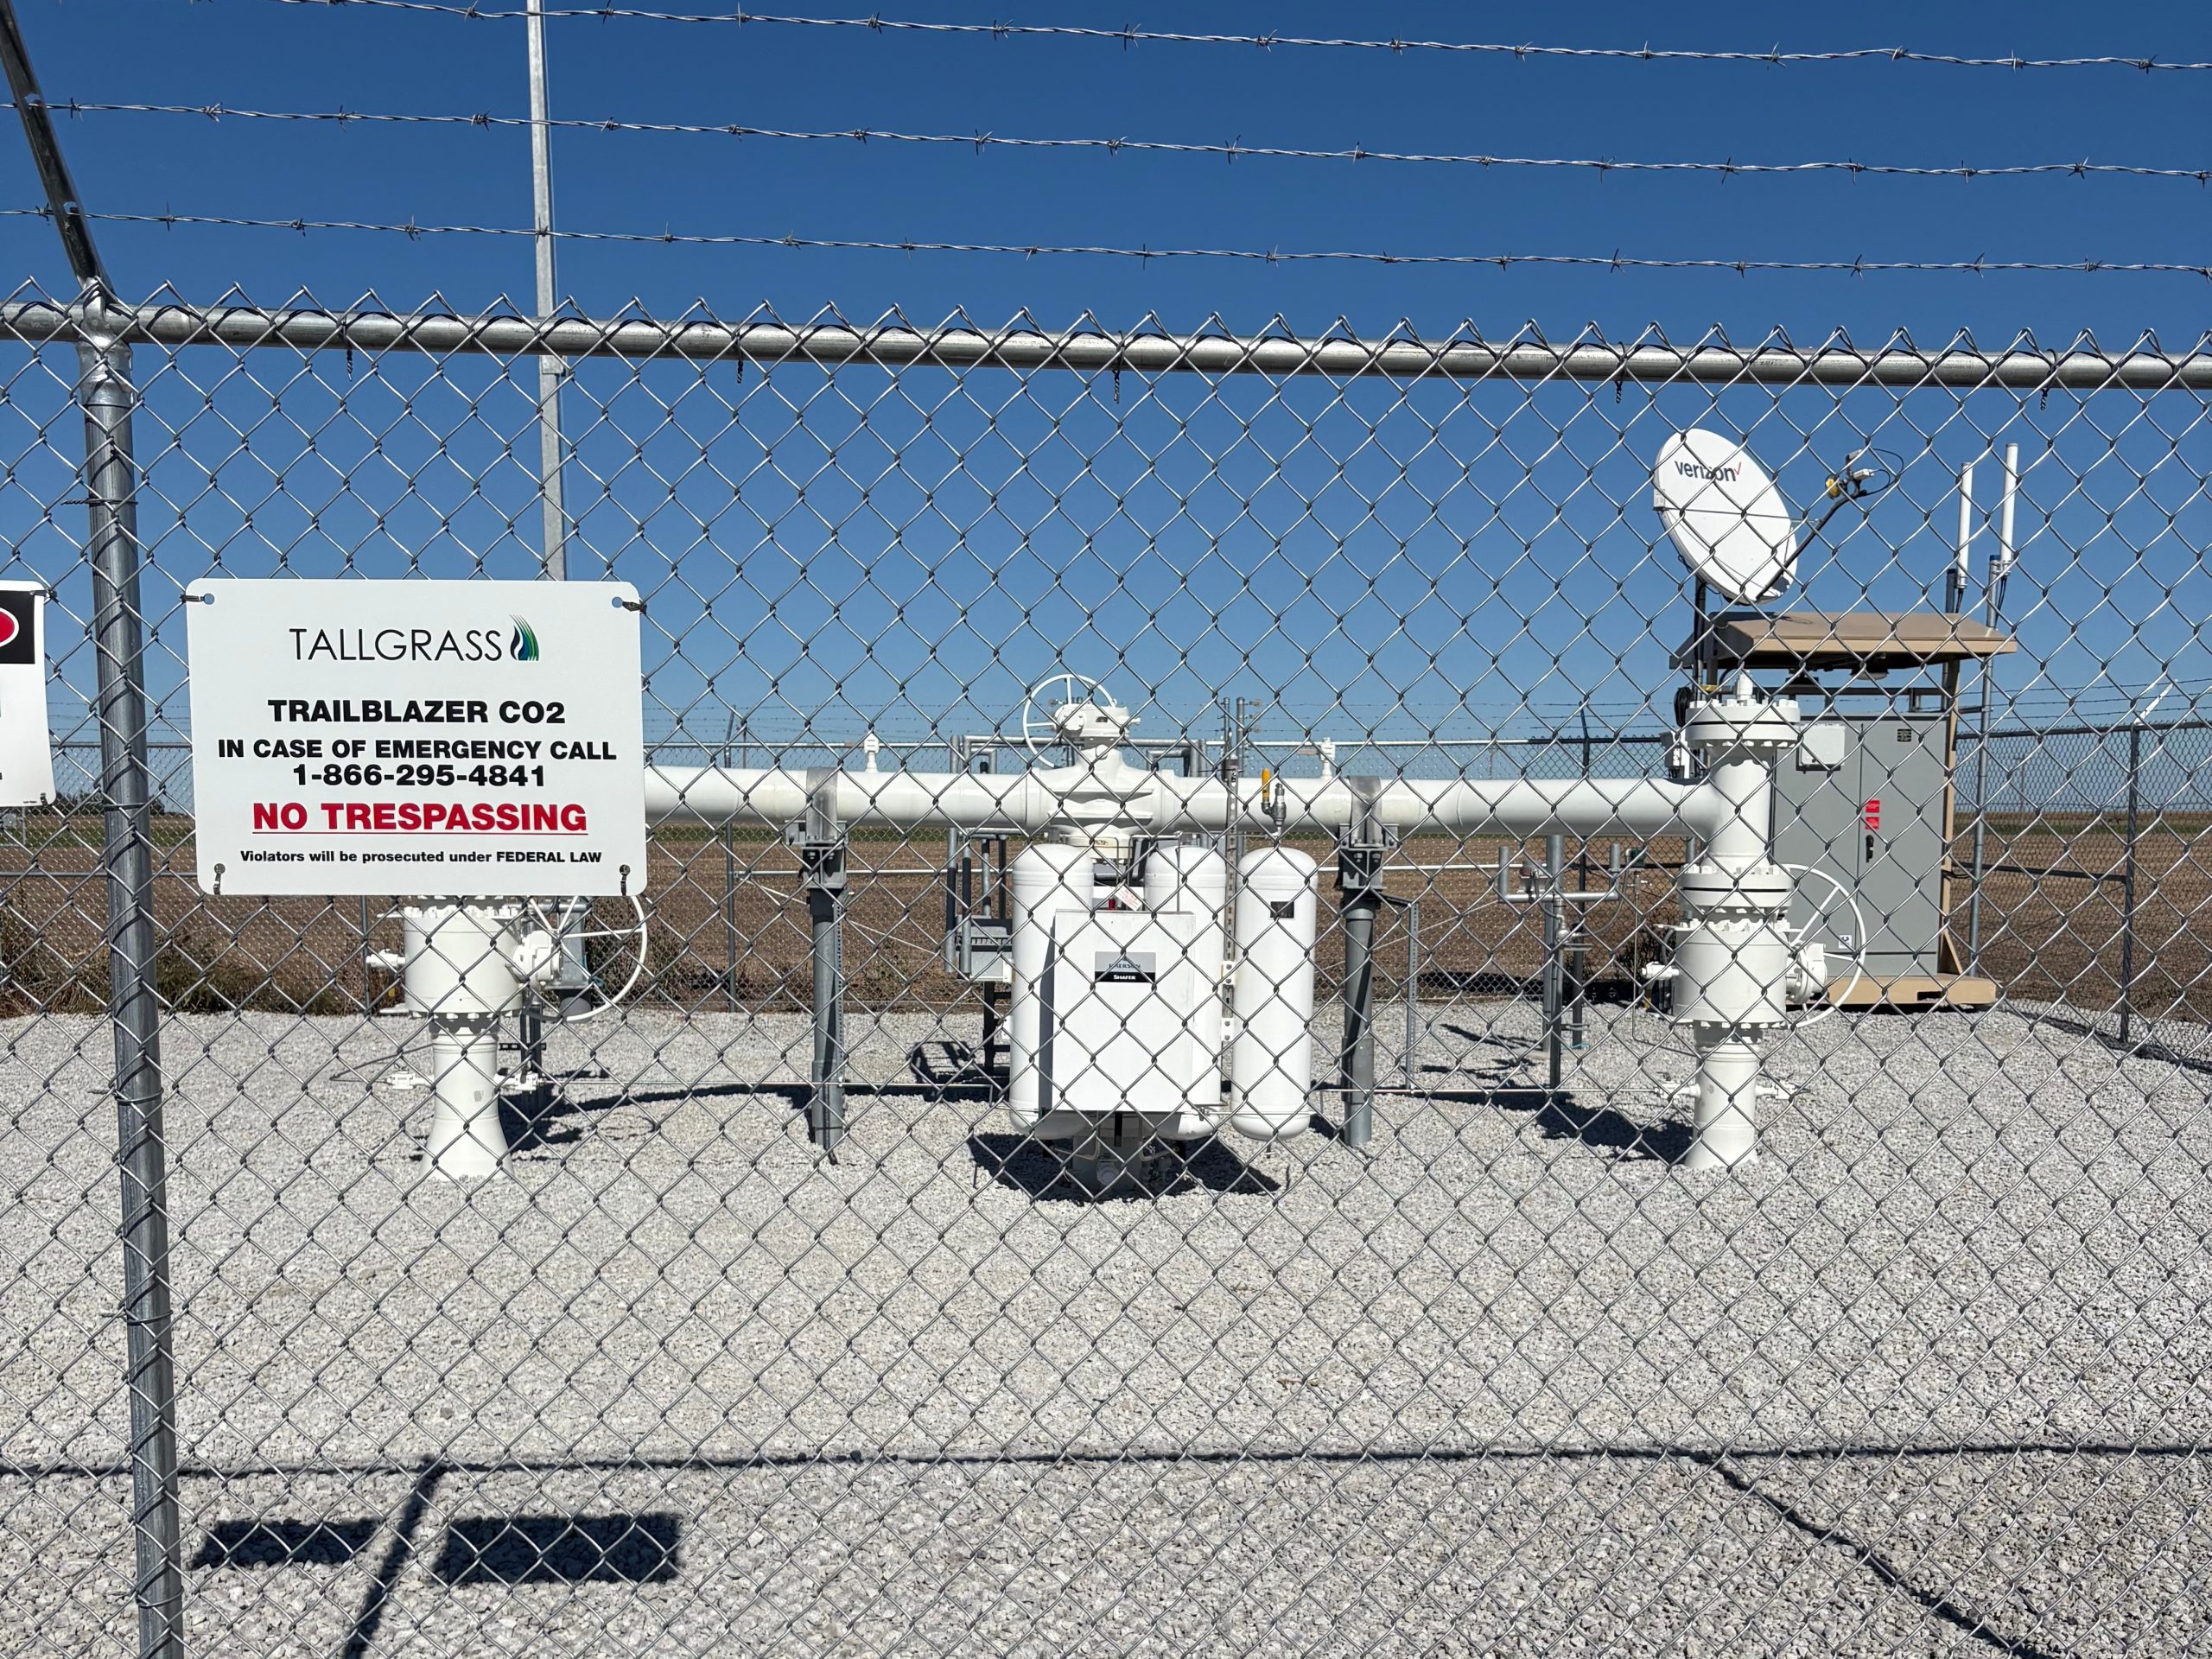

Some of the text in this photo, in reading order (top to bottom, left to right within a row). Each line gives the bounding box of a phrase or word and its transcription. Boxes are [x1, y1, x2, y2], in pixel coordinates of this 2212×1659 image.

[1674, 461, 1736, 482] verizon
[289, 629, 502, 661] TALLGRASS
[268, 700, 566, 724] TRAILBLAZER CO2
[218, 740, 617, 760] IN CASE OF EMERGENCY CALL
[294, 764, 544, 786] 1-866-295-4841
[252, 803, 588, 832] NO TRESPASSING
[240, 851, 602, 864] Violators will be prosecuted under FEDERAL LAW
